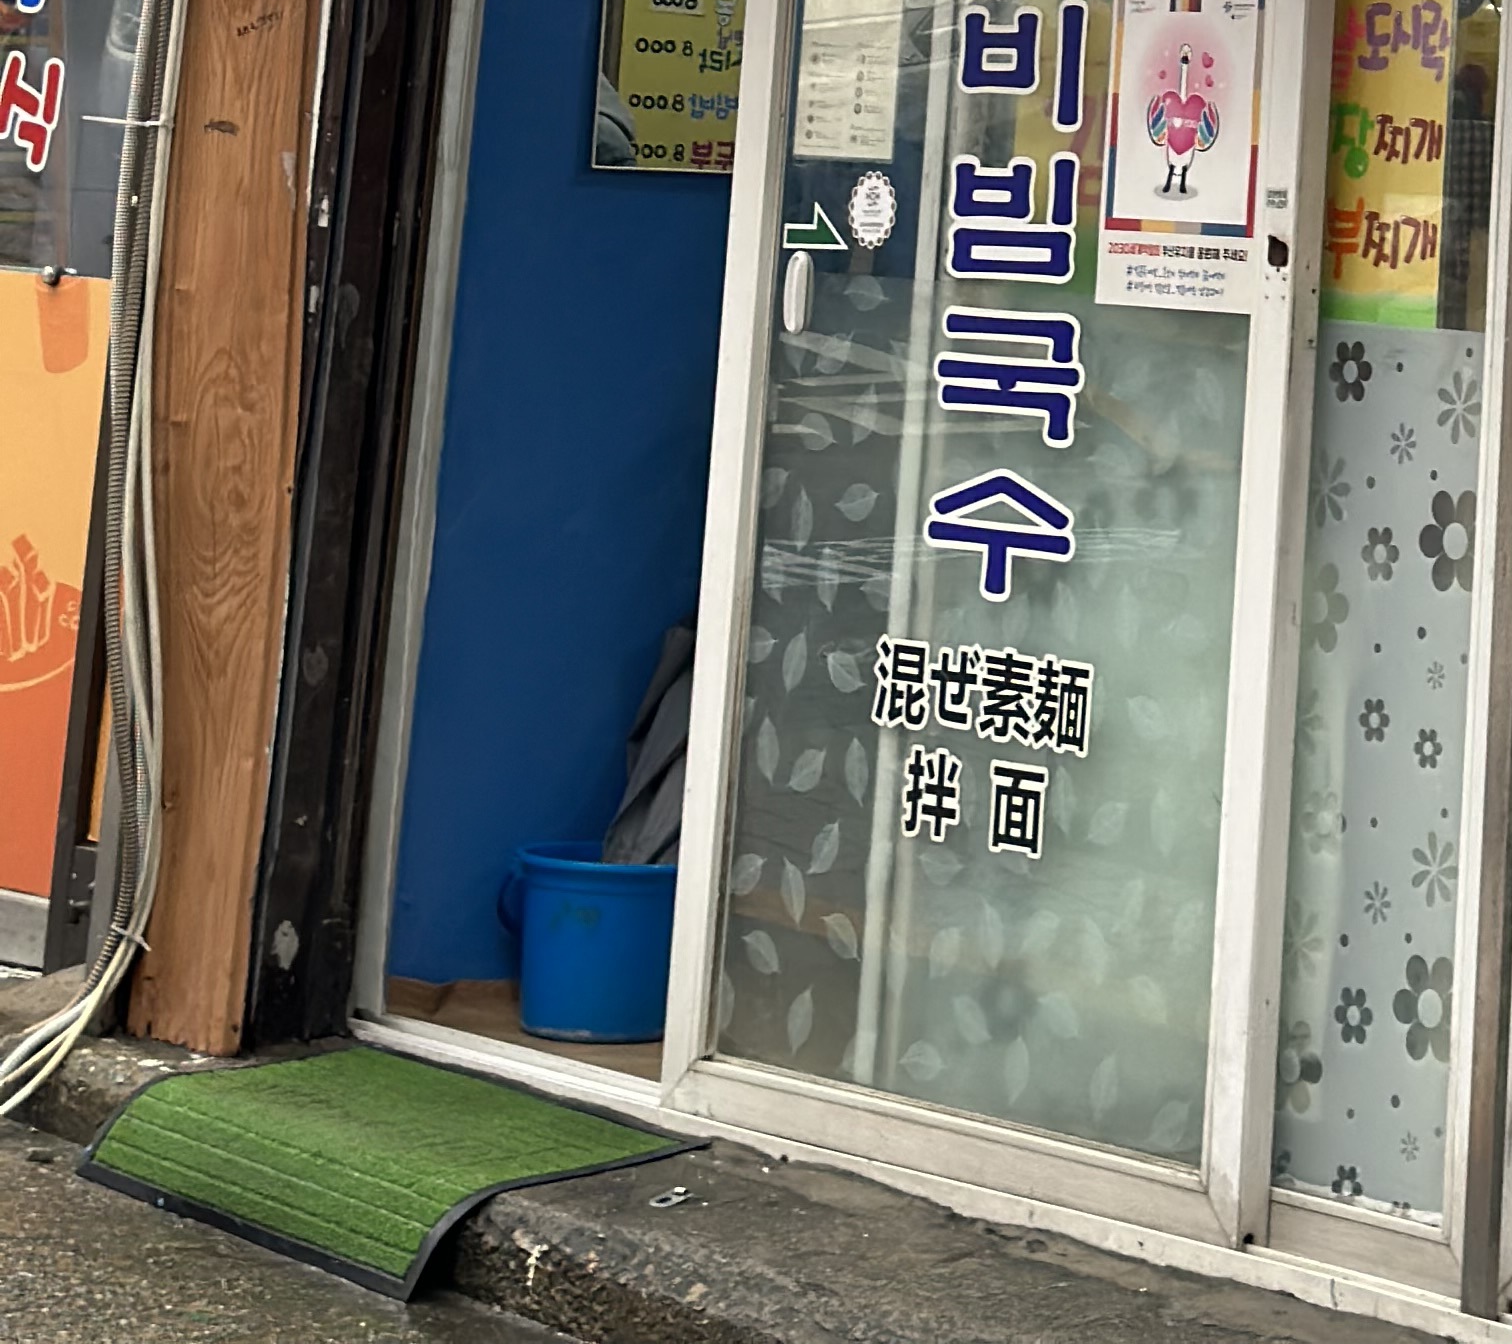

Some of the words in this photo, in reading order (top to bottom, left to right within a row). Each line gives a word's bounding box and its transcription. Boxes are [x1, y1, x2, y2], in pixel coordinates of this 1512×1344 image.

[925, 0, 1087, 598] 비빔국수
[874, 638, 1092, 754] 混ぜ素麺
